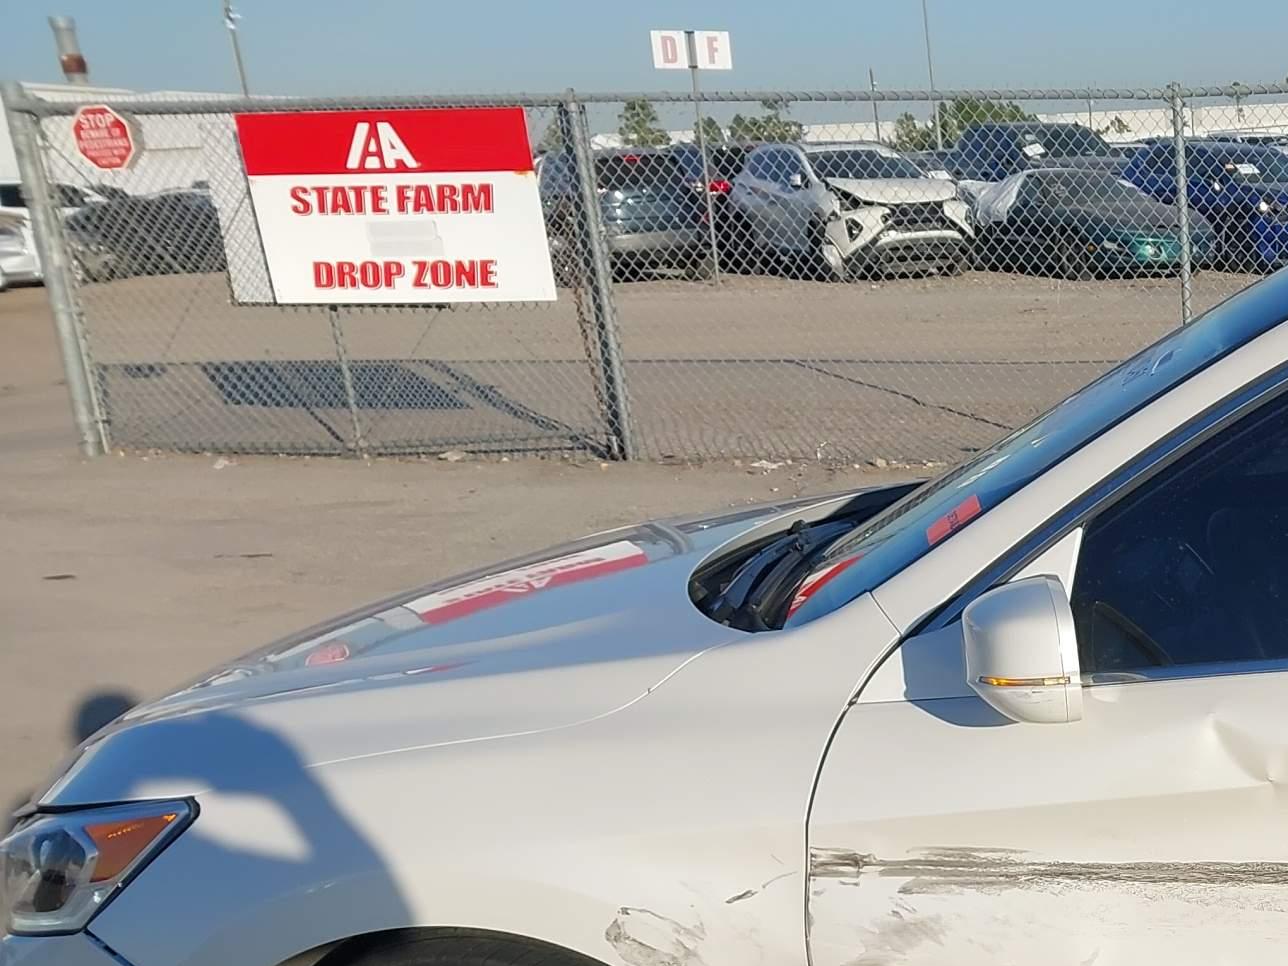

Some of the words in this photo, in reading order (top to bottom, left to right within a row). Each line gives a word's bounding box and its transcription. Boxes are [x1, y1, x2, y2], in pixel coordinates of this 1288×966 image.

[660, 36, 678, 64] D
[706, 36, 719, 64] F
[80, 113, 114, 130] STOP
[290, 185, 389, 215] STATE
[396, 183, 494, 214] FARM
[313, 261, 404, 290] DROP
[411, 259, 499, 289] ZONE
